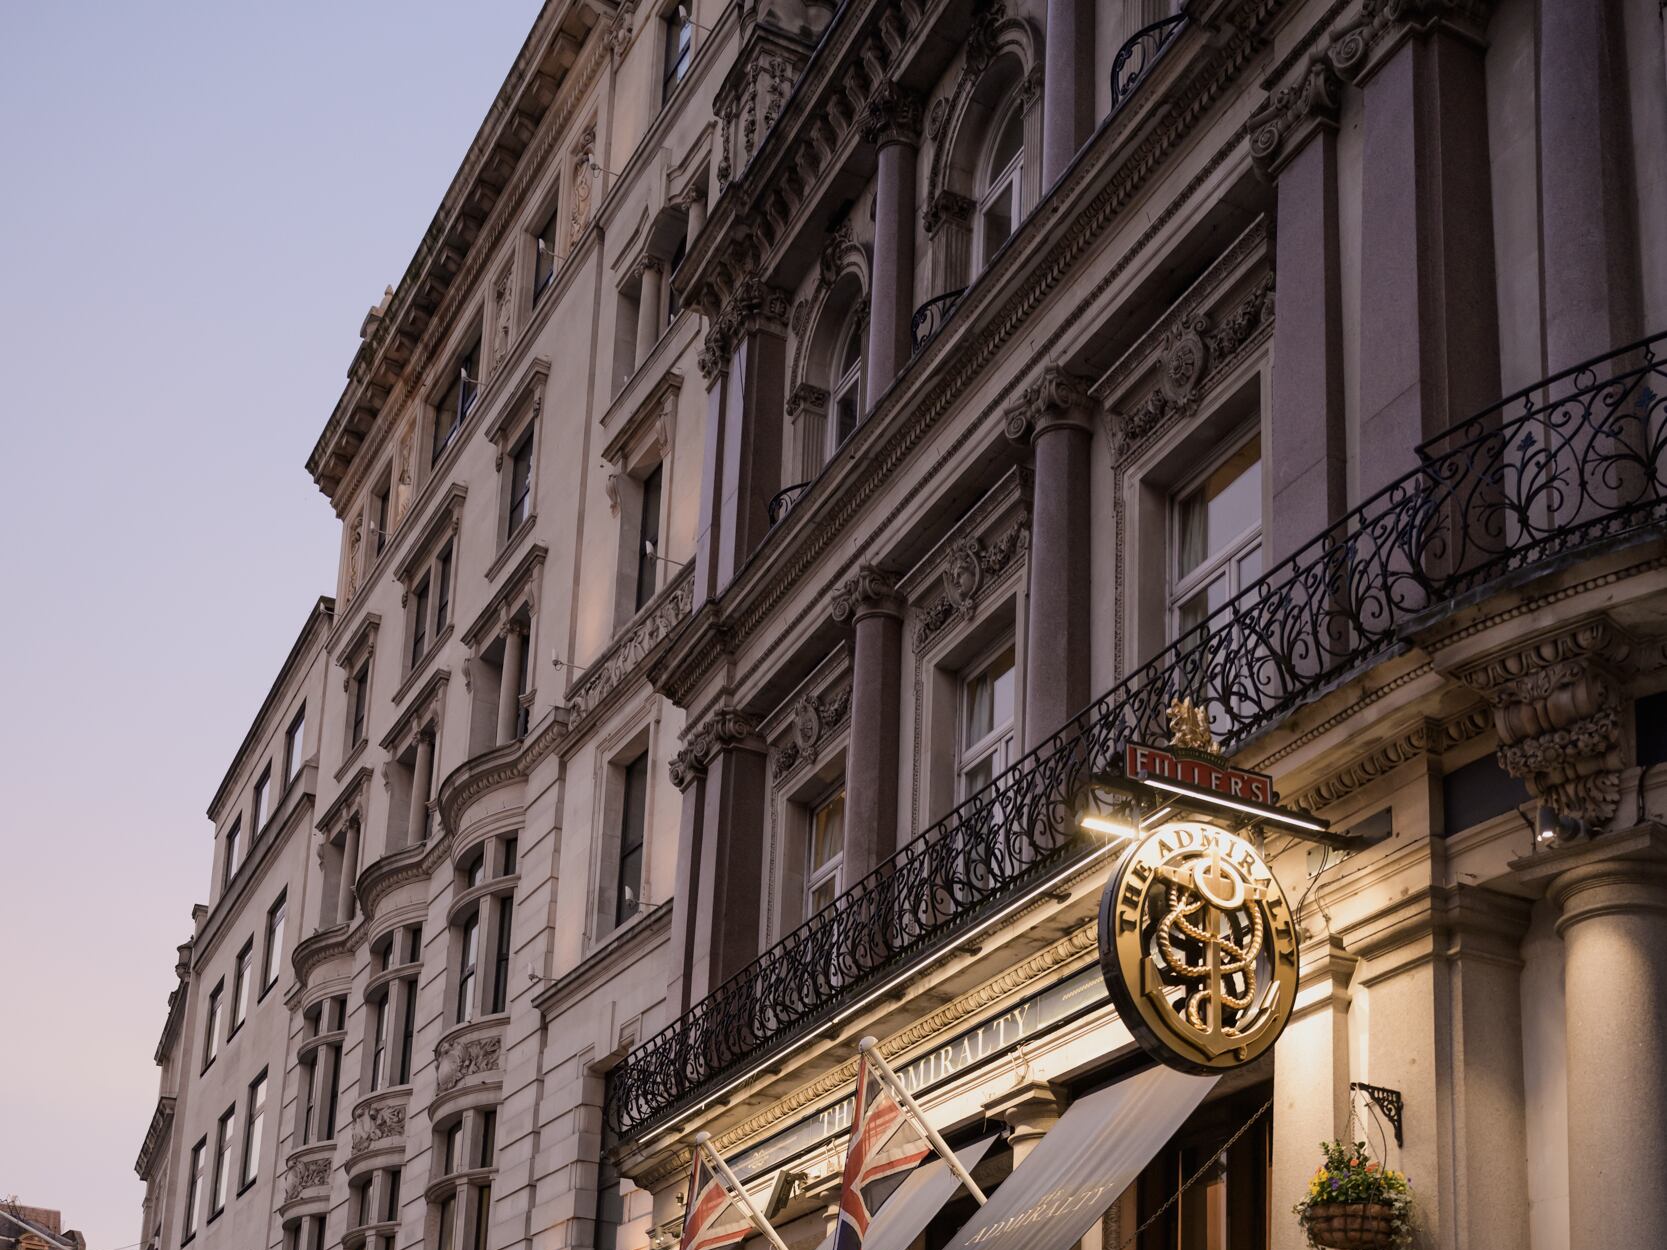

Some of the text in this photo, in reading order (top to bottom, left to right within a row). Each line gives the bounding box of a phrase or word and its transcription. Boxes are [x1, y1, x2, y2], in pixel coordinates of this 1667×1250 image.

[1118, 828, 1296, 967] THE ADMIRALTY
[819, 1004, 1030, 1137] TH DMIRALTY
[963, 1183, 1114, 1246] ADMIRALTY
